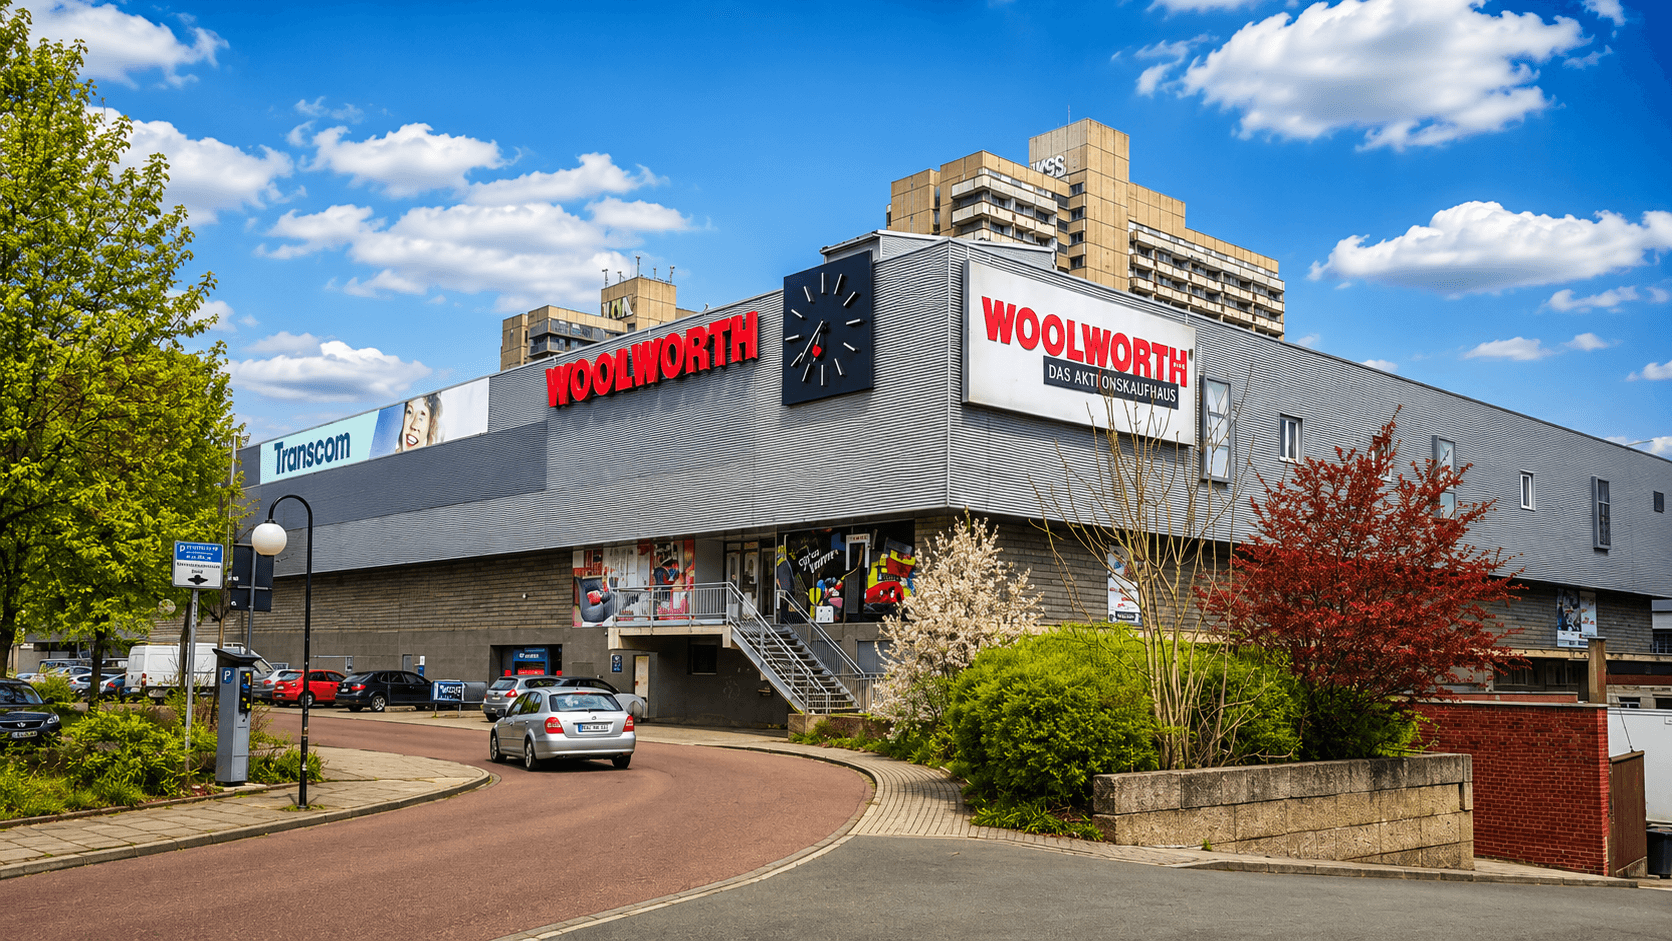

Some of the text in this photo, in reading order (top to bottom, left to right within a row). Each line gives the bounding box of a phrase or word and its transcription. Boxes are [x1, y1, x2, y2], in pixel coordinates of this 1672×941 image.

[545, 310, 759, 408] WOOLWORTH
[981, 296, 1188, 388] WOOLWORTH
[1048, 364, 1177, 403] DAS AKTIONSKAUFHAUS
[274, 431, 351, 475] Transcom
[224, 670, 231, 681] P
